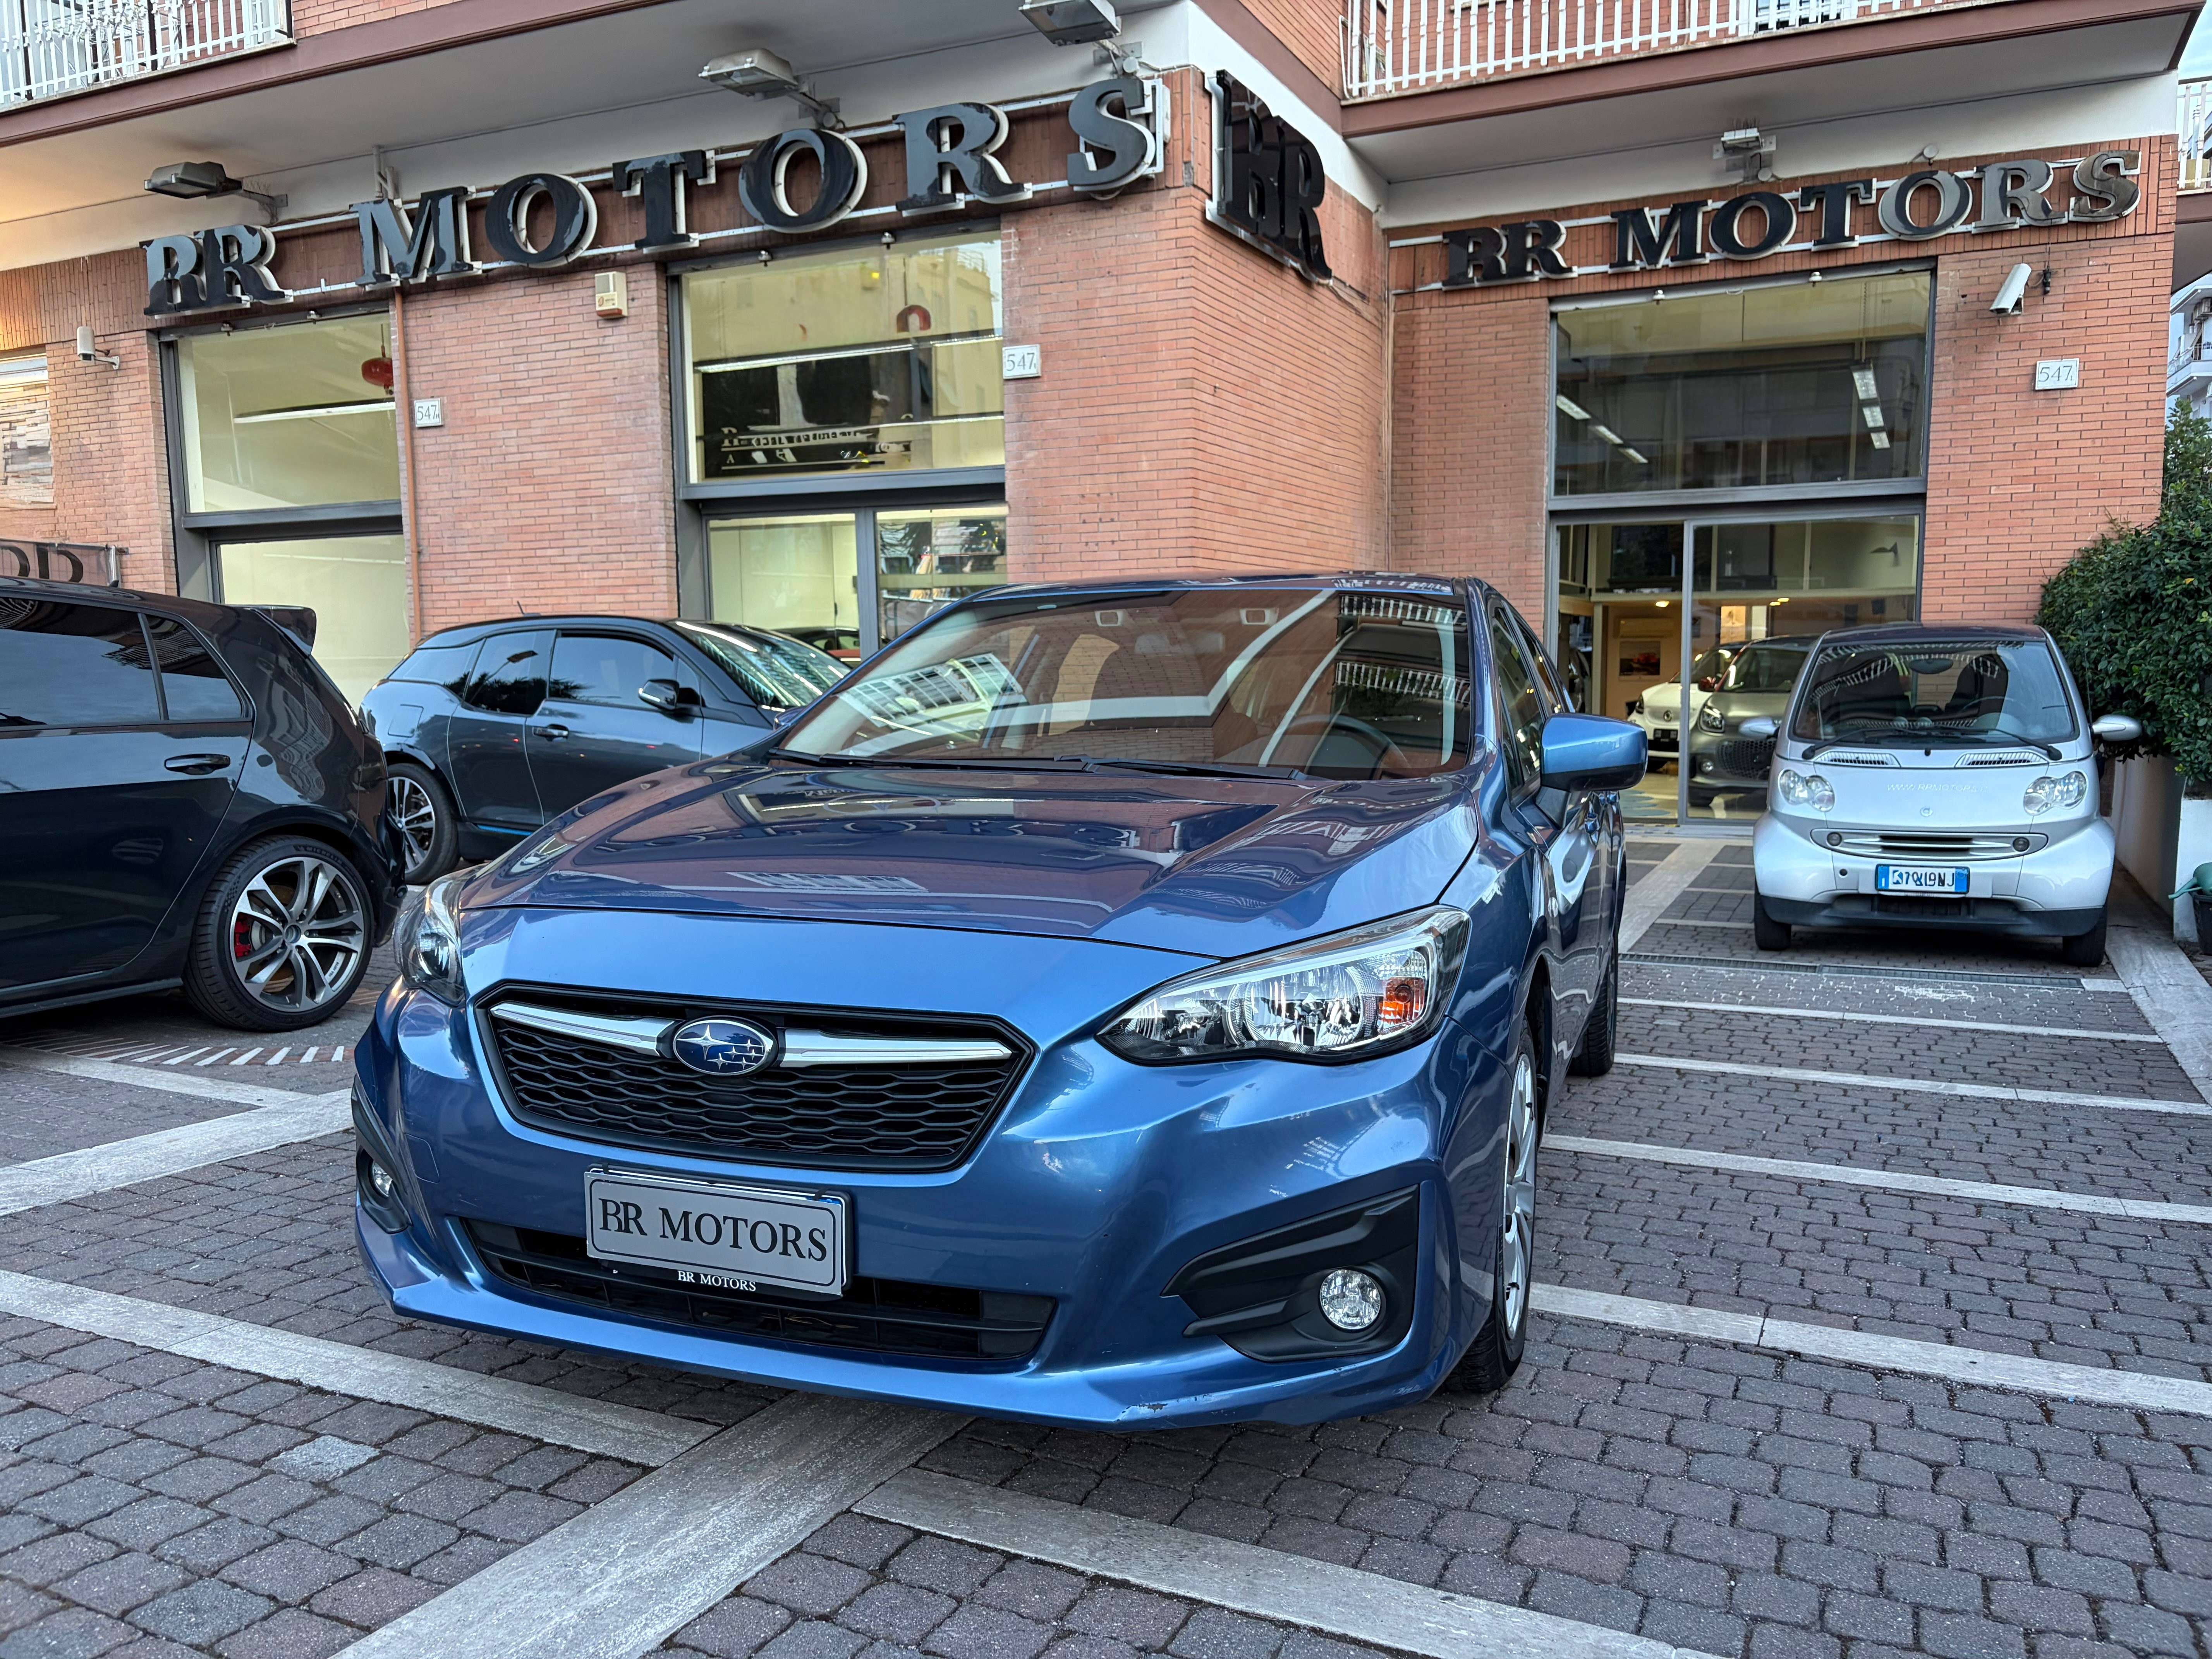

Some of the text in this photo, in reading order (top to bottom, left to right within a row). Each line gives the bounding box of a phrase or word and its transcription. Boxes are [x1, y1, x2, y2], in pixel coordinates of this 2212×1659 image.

[350, 77, 1157, 291] MOTORS
[1609, 149, 2142, 273] MOTORS
[599, 1198, 827, 1262] BR MOTORS
[678, 1270, 756, 1292] BR MOTORS
